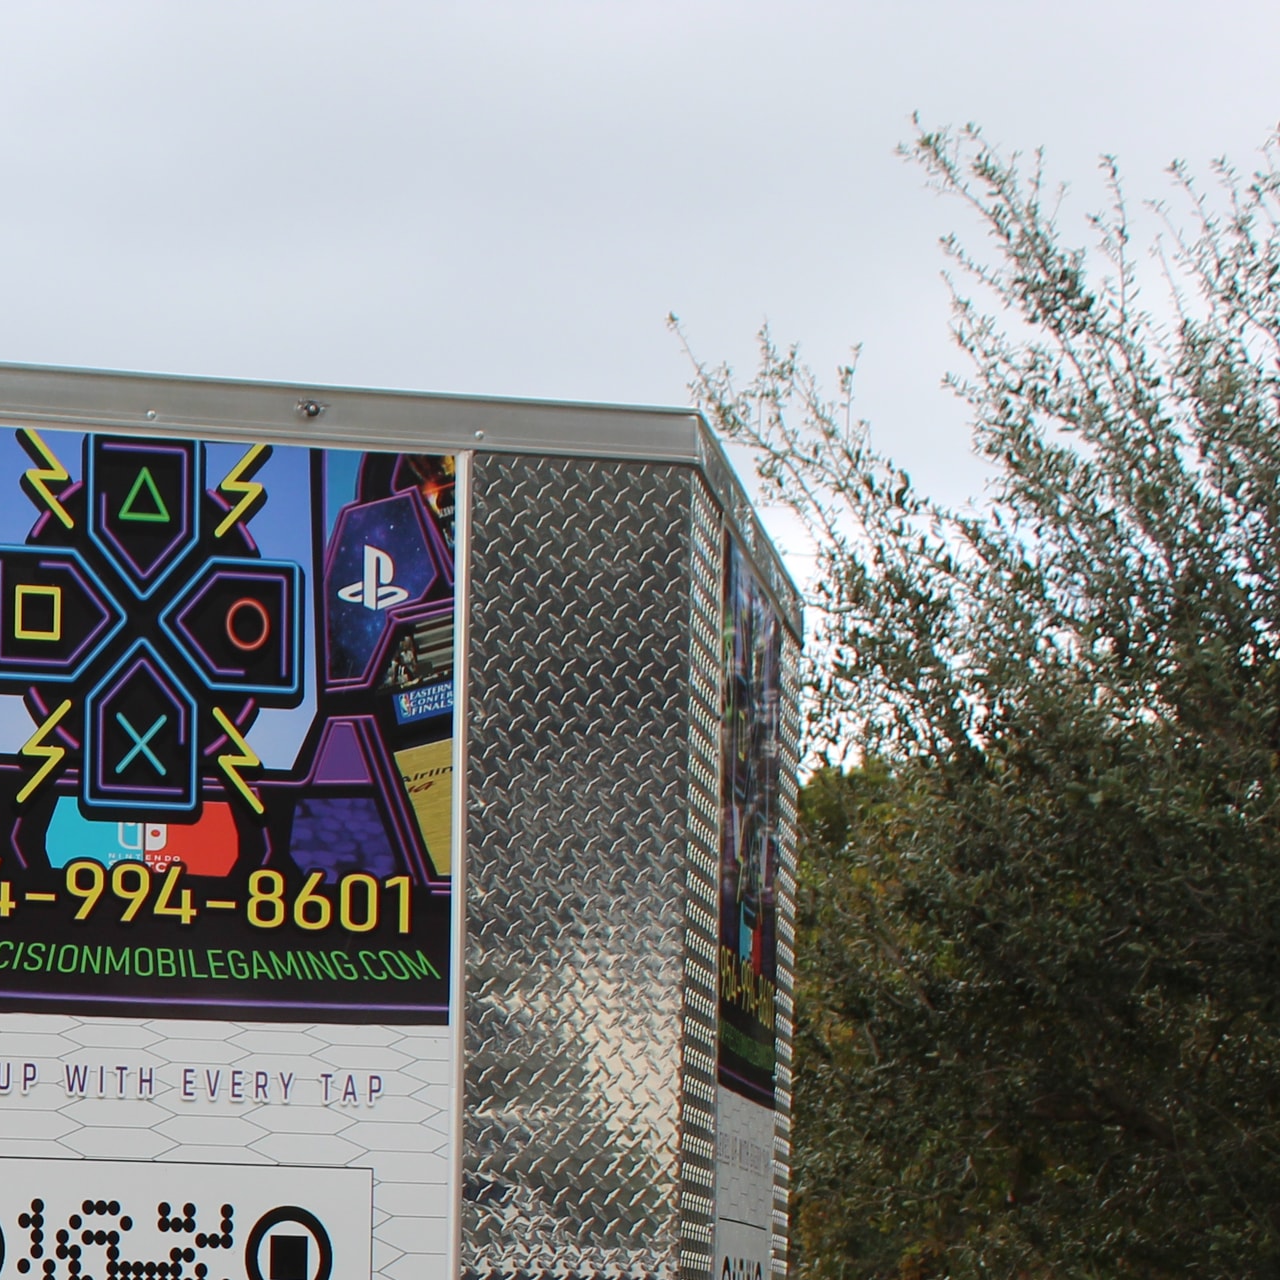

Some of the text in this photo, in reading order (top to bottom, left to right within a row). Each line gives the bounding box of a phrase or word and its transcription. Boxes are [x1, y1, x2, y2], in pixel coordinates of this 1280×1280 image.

[410, 682, 452, 700] EASTERN
[412, 699, 454, 716] FINALS
[107, 852, 181, 862] NINTENDO
[65, 1064, 156, 1097] WITH
[182, 1068, 295, 1101] EVERY
[321, 1073, 384, 1103] TAP
